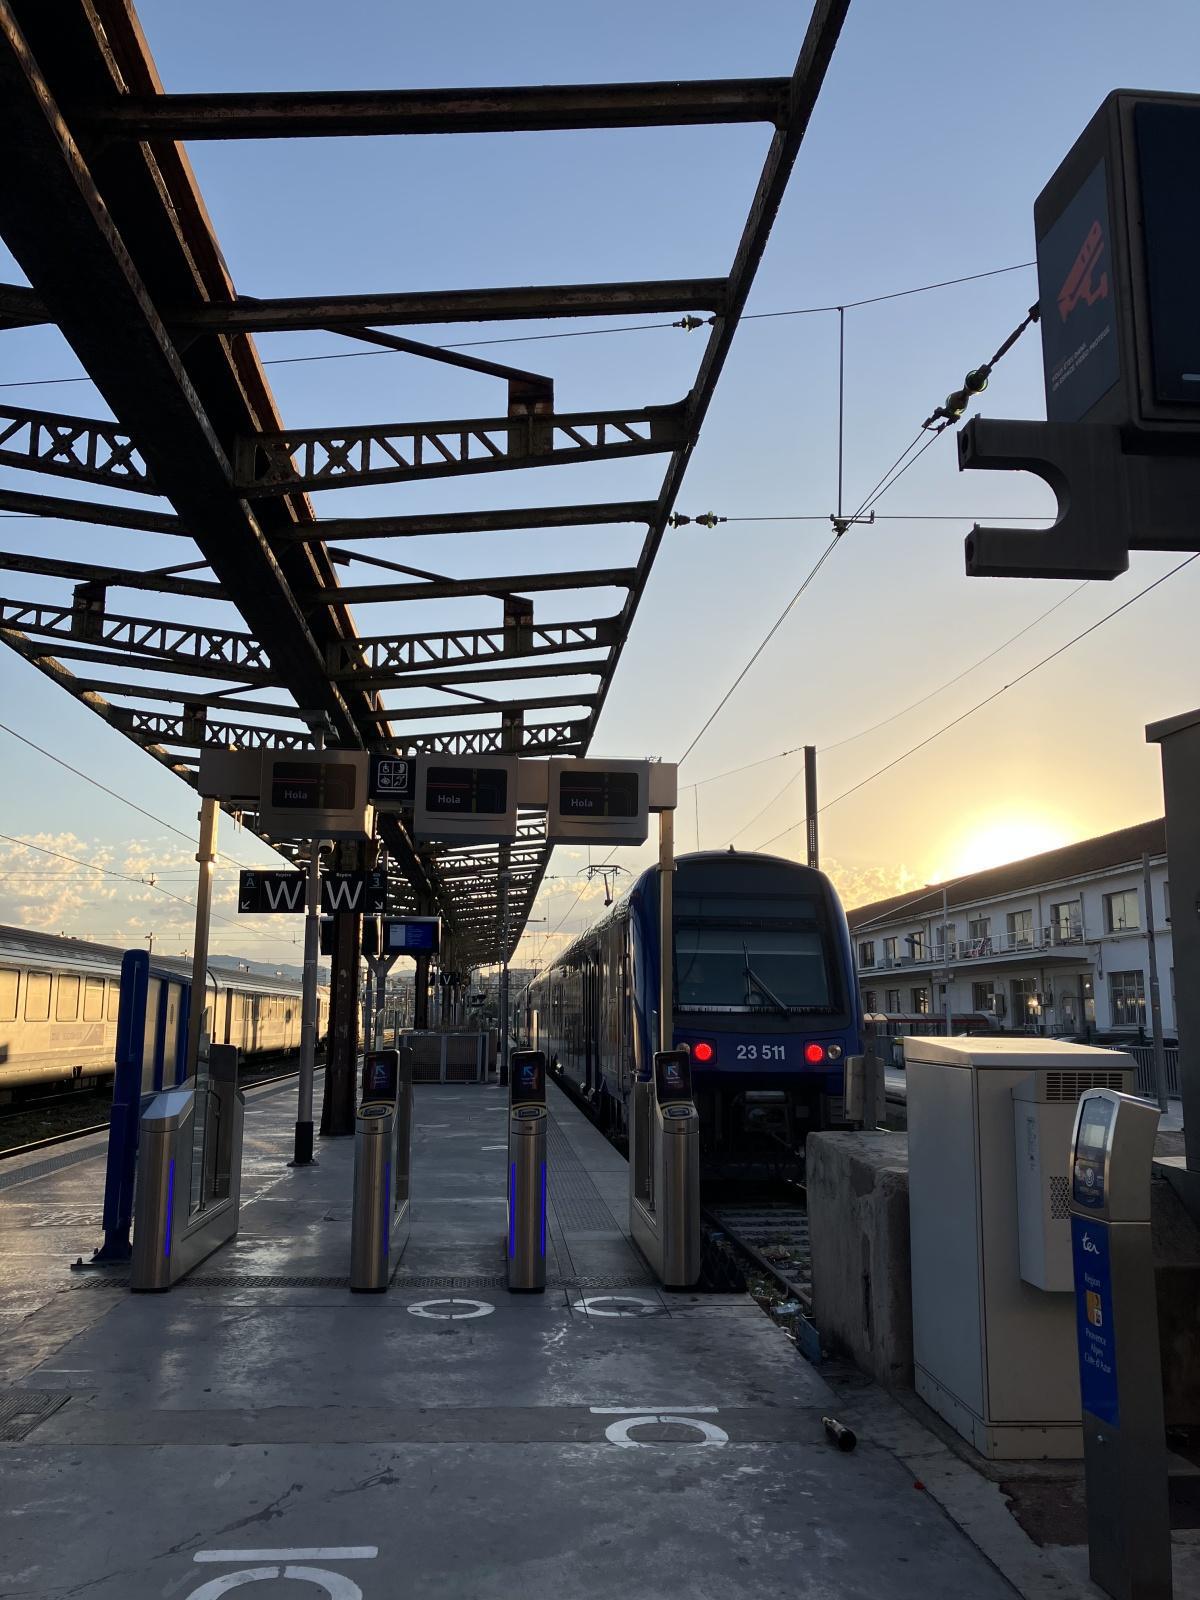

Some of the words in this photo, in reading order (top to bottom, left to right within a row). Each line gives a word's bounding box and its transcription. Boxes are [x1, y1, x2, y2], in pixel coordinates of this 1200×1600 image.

[284, 789, 308, 800] Hola
[437, 794, 462, 804] Hola
[570, 798, 593, 808] Hola
[246, 877, 255, 887] A
[373, 877, 381, 887] 3
[264, 880, 303, 910] W
[325, 880, 364, 910] W
[736, 1044, 758, 1060] 23
[761, 1044, 786, 1060] 511
[1081, 1231, 1101, 1256] ter
